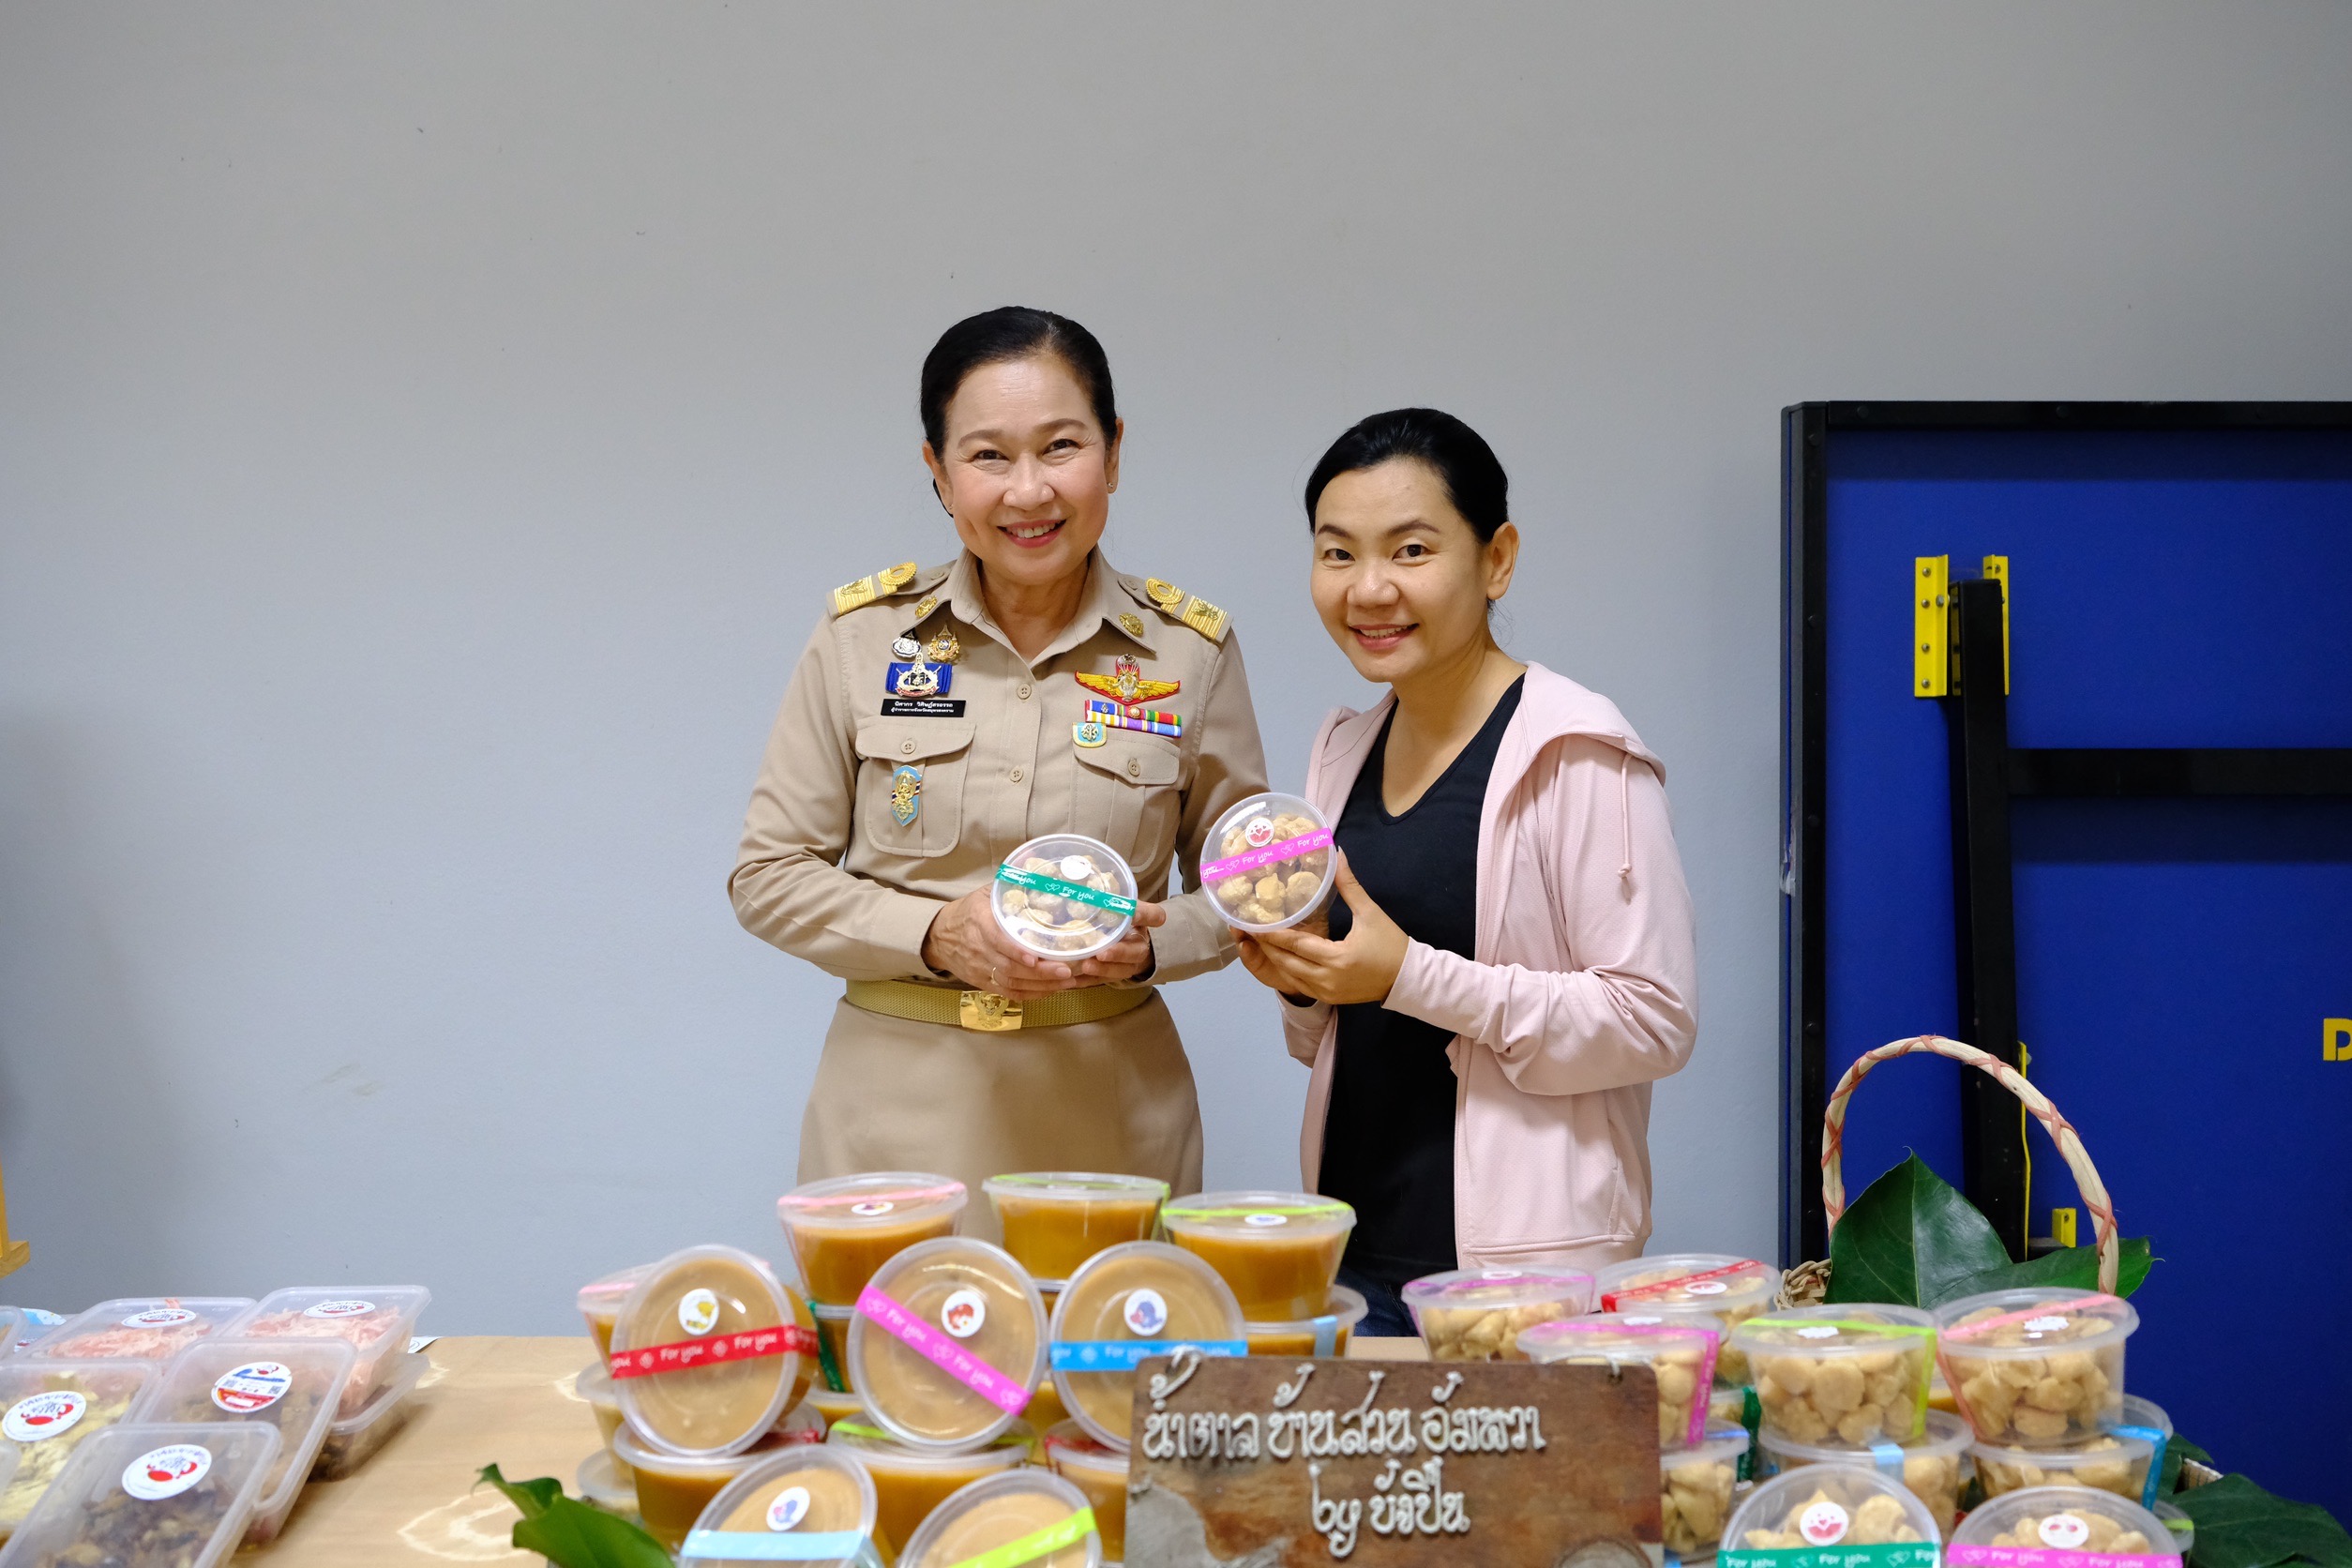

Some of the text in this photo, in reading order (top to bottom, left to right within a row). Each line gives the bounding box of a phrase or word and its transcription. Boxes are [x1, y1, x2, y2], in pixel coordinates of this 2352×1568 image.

[1297, 833, 1329, 849] For you
[1243, 851, 1274, 865] For you
[1062, 885, 1094, 901] For you
[734, 1335, 753, 1349] For
[754, 1334, 777, 1351] you
[659, 1345, 703, 1364] For you
[1142, 1354, 1260, 1458] น้ำตาล
[1308, 1463, 1362, 1558] by
[1819, 1553, 1871, 1568] For you
[1991, 1550, 2045, 1566] For you
[2089, 1556, 2111, 1568] For
